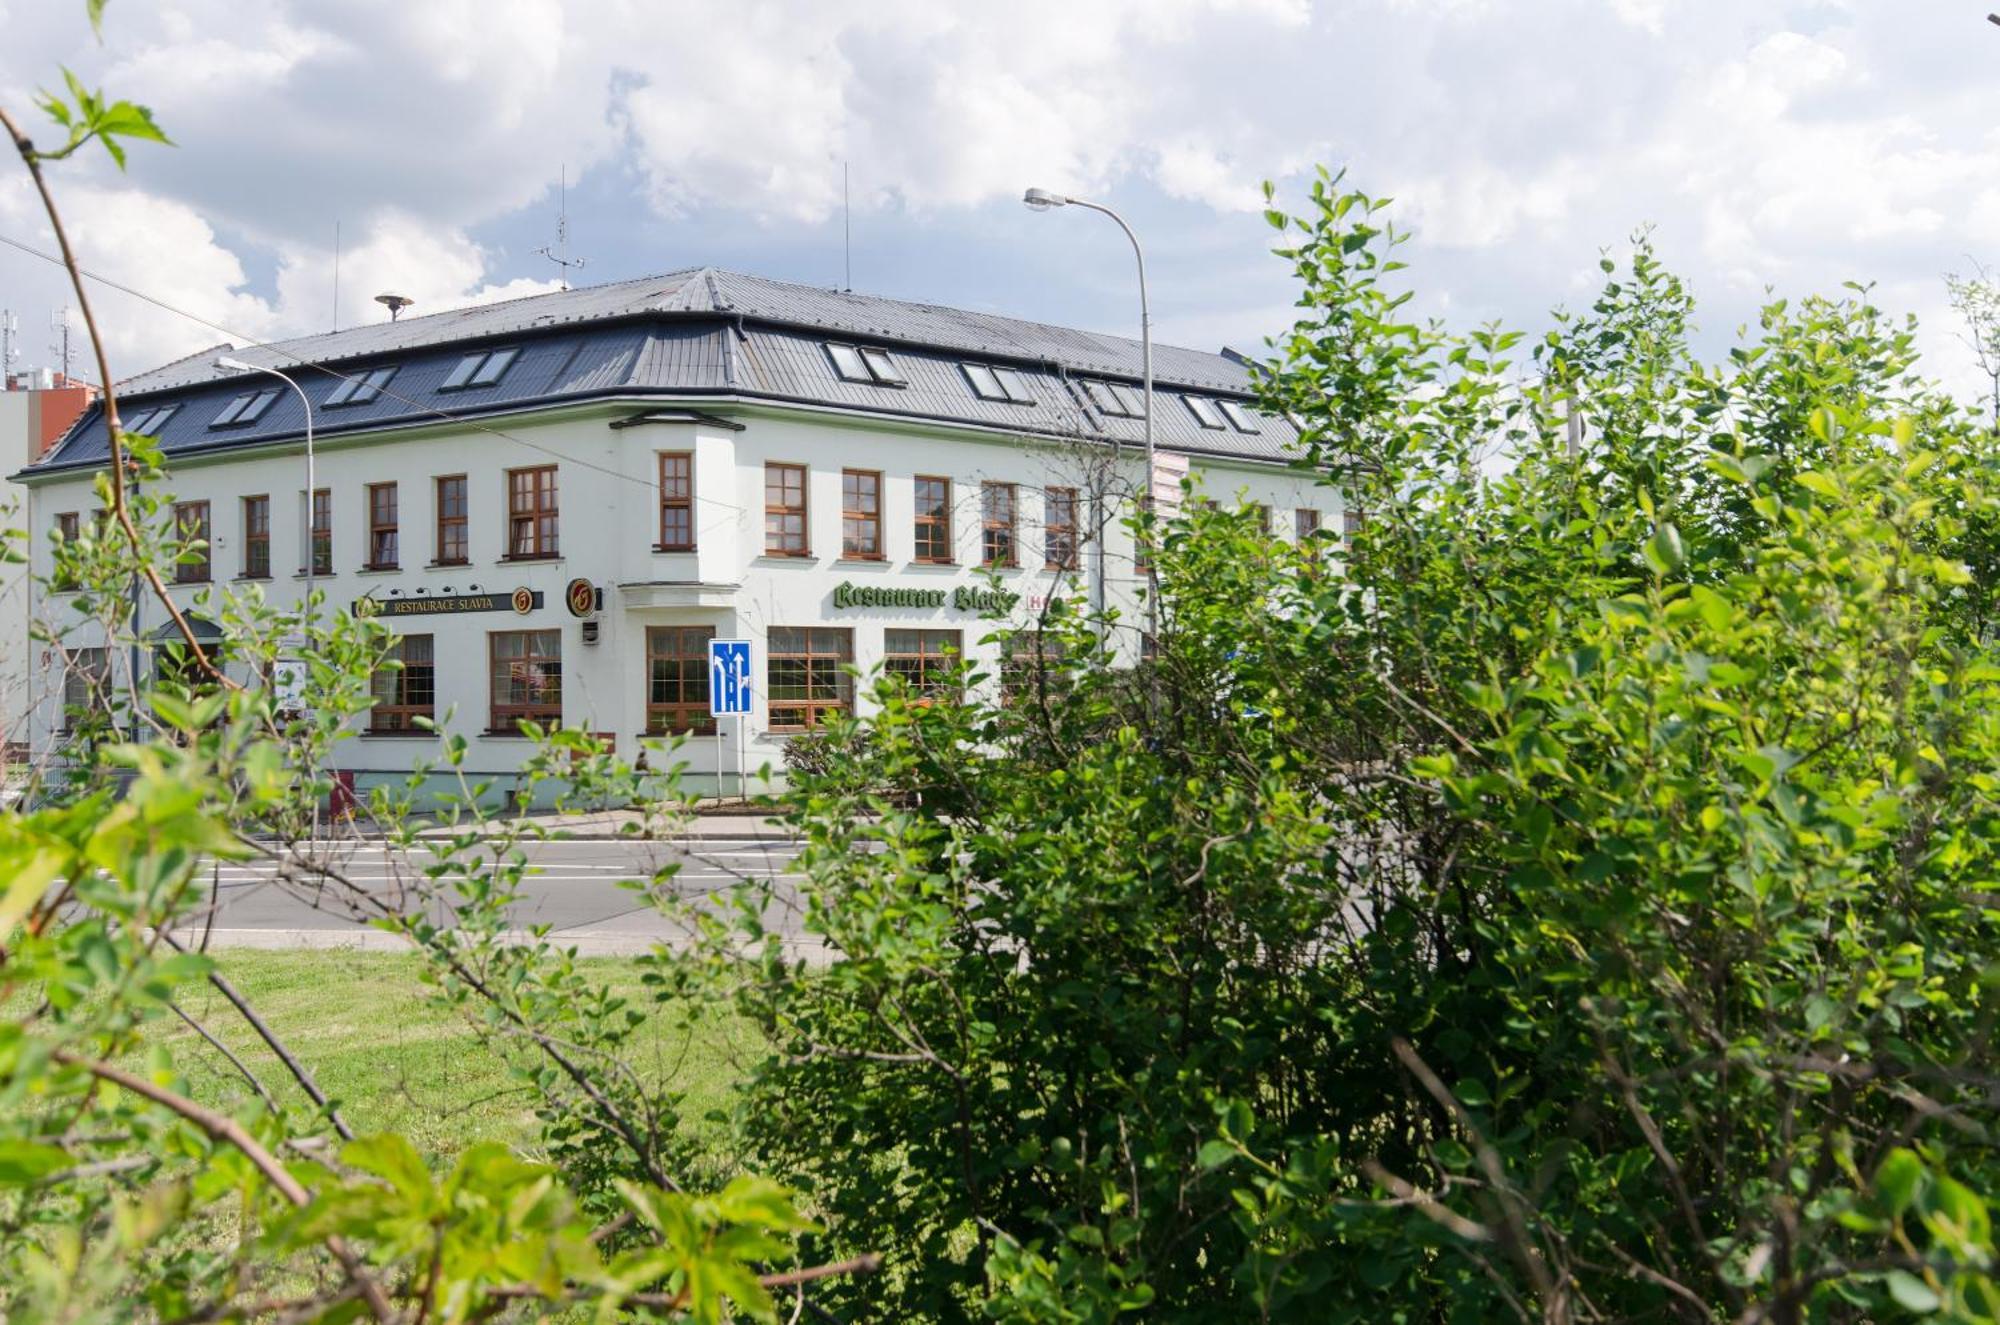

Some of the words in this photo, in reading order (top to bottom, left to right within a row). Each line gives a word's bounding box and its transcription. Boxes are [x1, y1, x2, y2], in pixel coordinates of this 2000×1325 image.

[394, 600, 455, 613] RESTAURACE
[458, 597, 493, 609] SLAVIA
[833, 580, 947, 609] Restaurace
